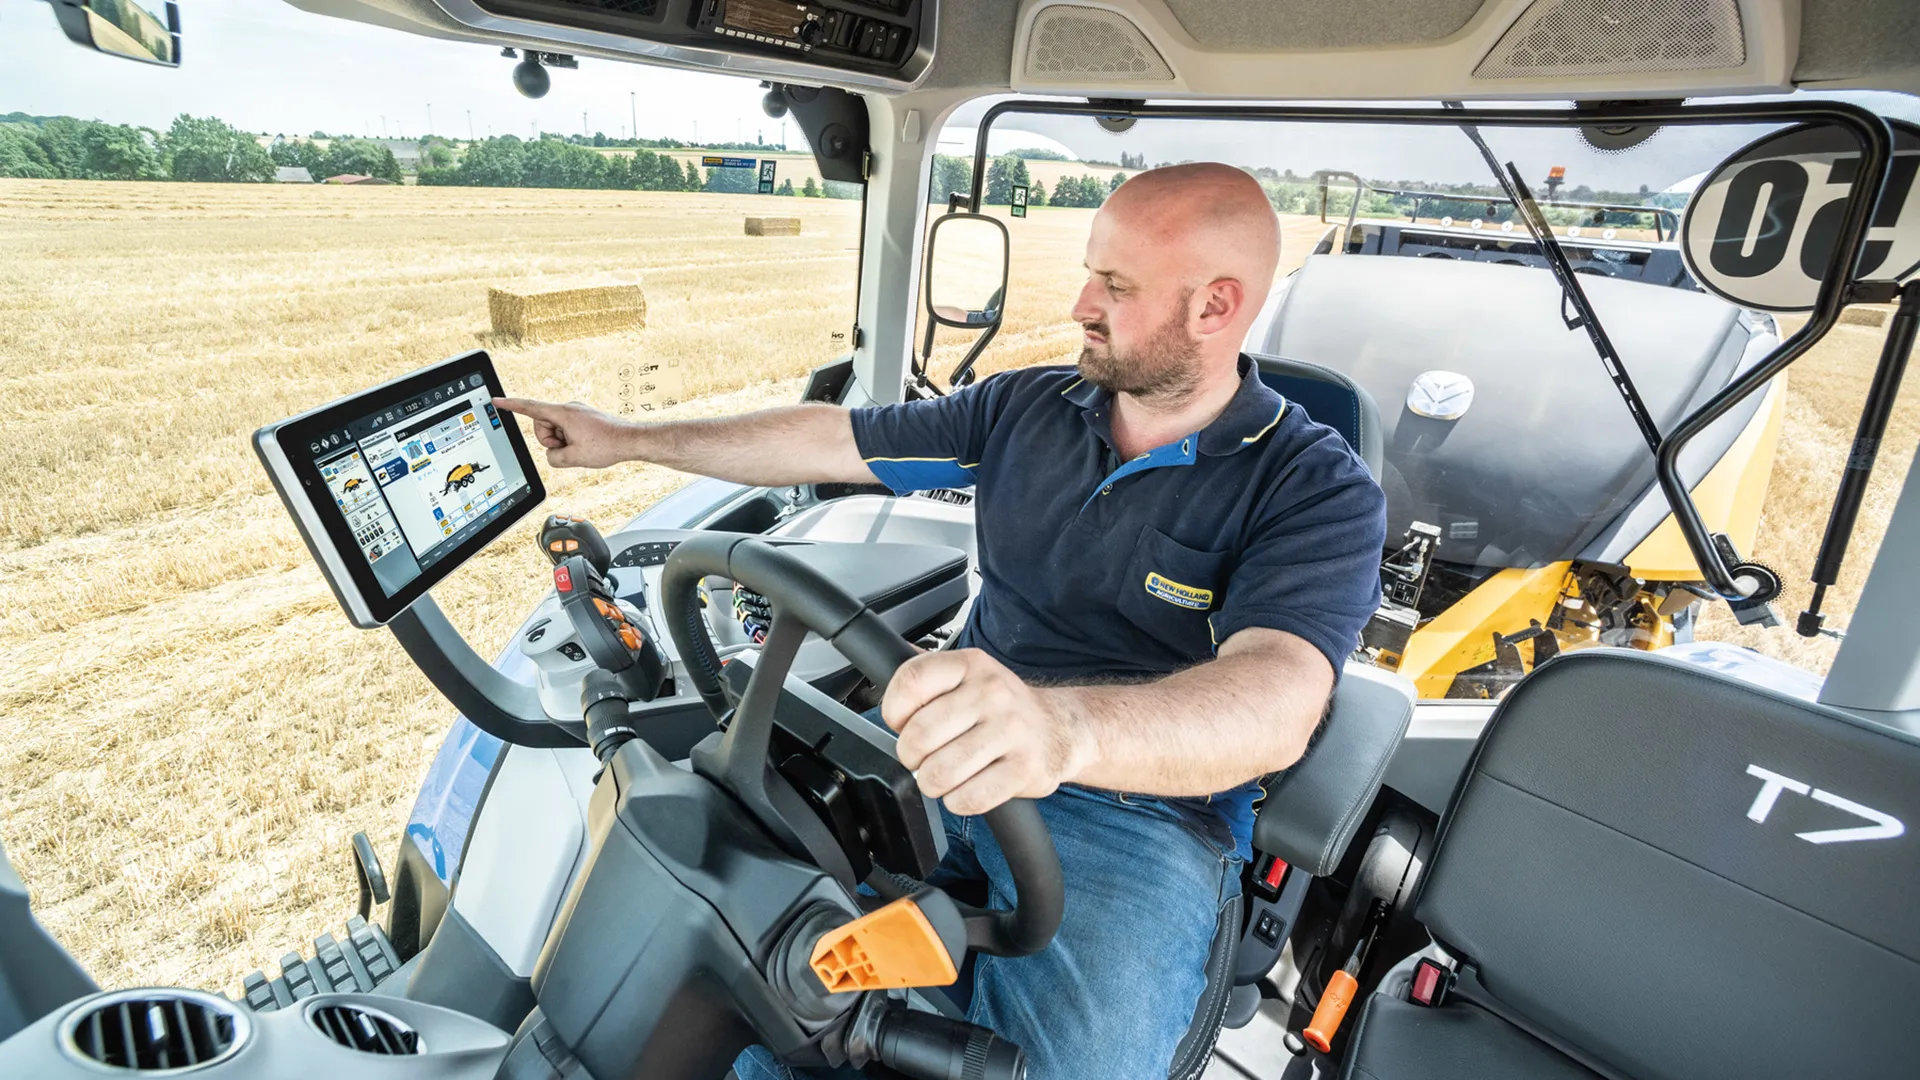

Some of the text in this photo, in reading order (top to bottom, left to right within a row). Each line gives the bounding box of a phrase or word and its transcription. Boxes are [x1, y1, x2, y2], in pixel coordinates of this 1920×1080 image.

[1156, 590, 1199, 607] AGRICULTURE
[1160, 582, 1209, 600] NEW HOLLAND
[1746, 764, 1905, 844] T7
